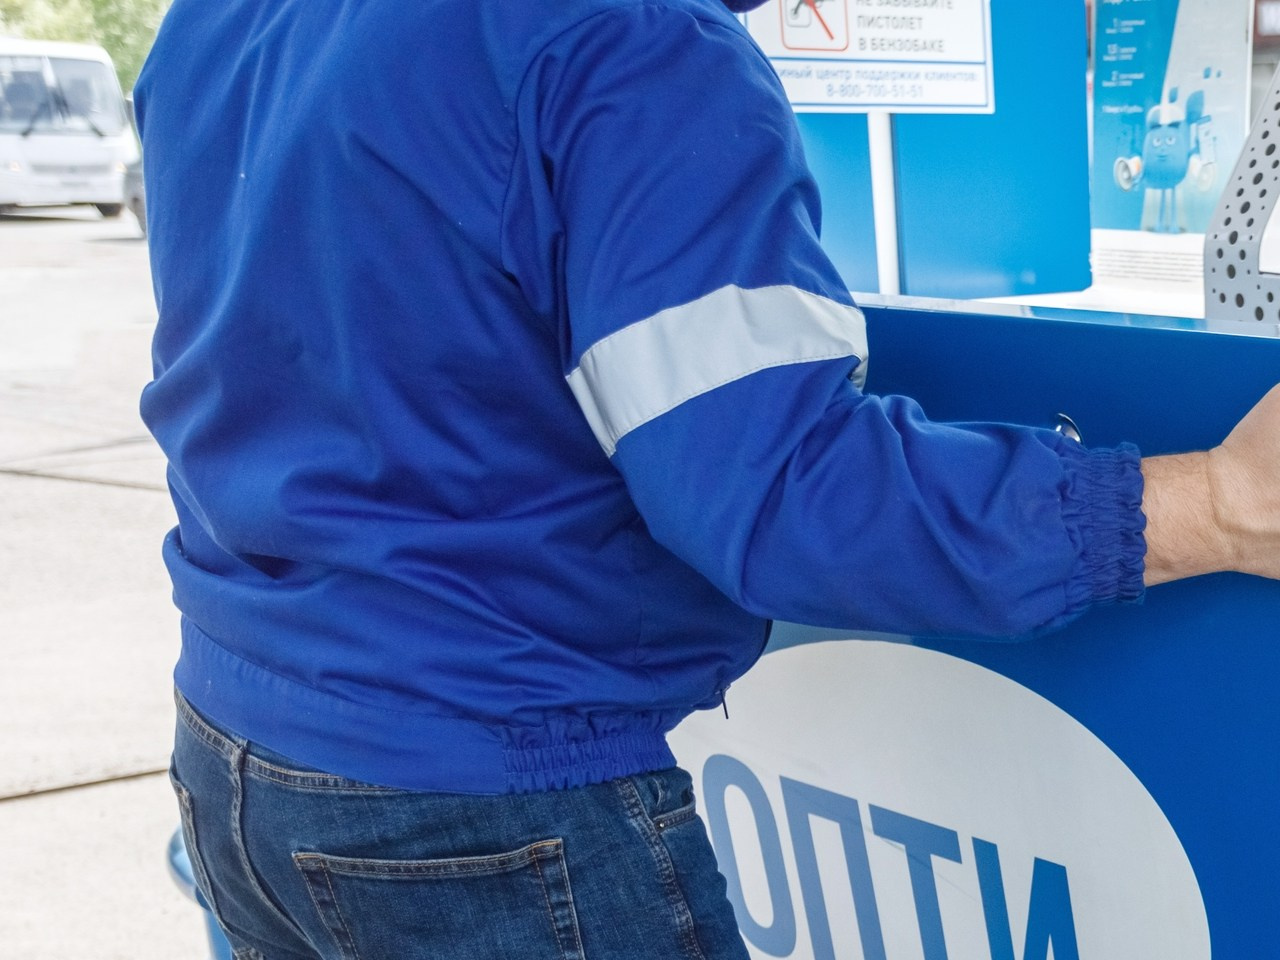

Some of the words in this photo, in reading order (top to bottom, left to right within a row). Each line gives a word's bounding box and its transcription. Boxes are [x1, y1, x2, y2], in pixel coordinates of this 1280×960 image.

[857, 15, 923, 30] ПИСТОЛЕТ
[859, 38, 867, 51] В
[871, 38, 945, 53] БЕНЗОБАКЕ
